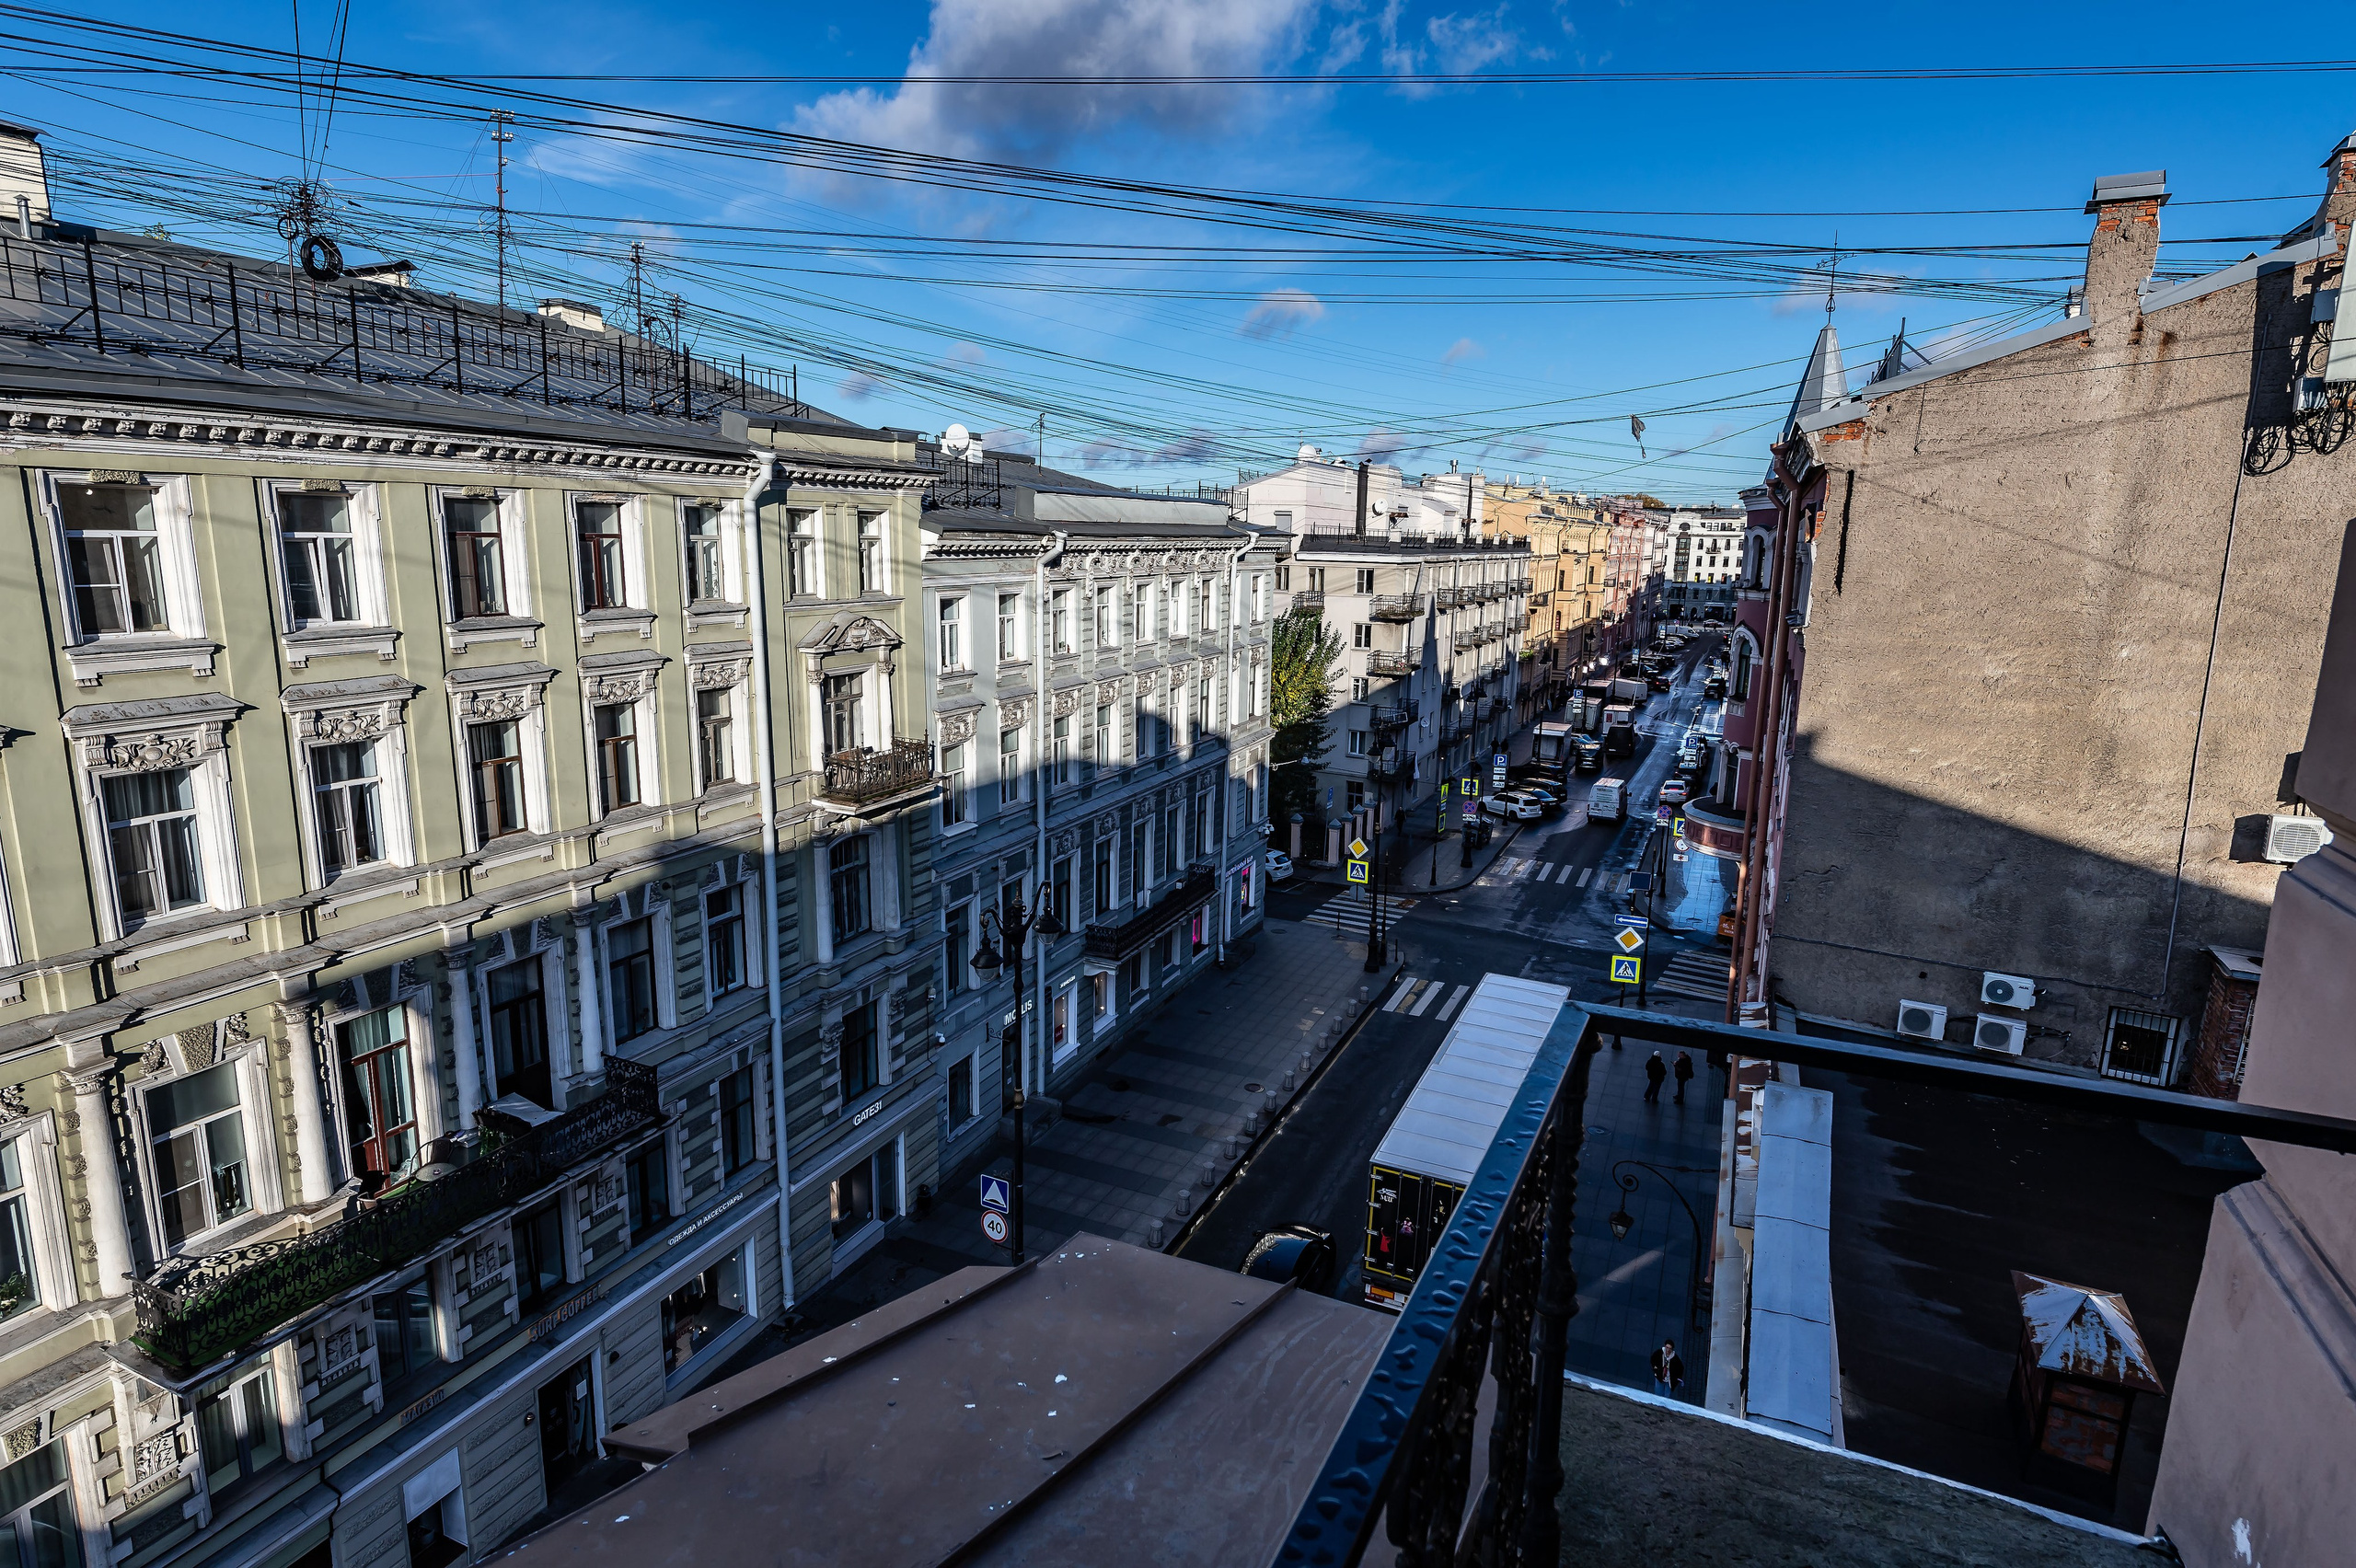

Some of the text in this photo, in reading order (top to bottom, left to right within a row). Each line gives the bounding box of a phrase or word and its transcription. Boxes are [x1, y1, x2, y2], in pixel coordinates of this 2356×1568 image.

[1496, 755, 1505, 766] P
[852, 1100, 883, 1126] GATE31
[668, 1224, 697, 1246] ОДЕЖДА
[703, 1192, 744, 1223] АКСЕССУАРЫ
[987, 1219, 1002, 1234] 40
[529, 1286, 599, 1343] SURF COFFEE
[401, 1389, 445, 1425] МАГАЗИН
